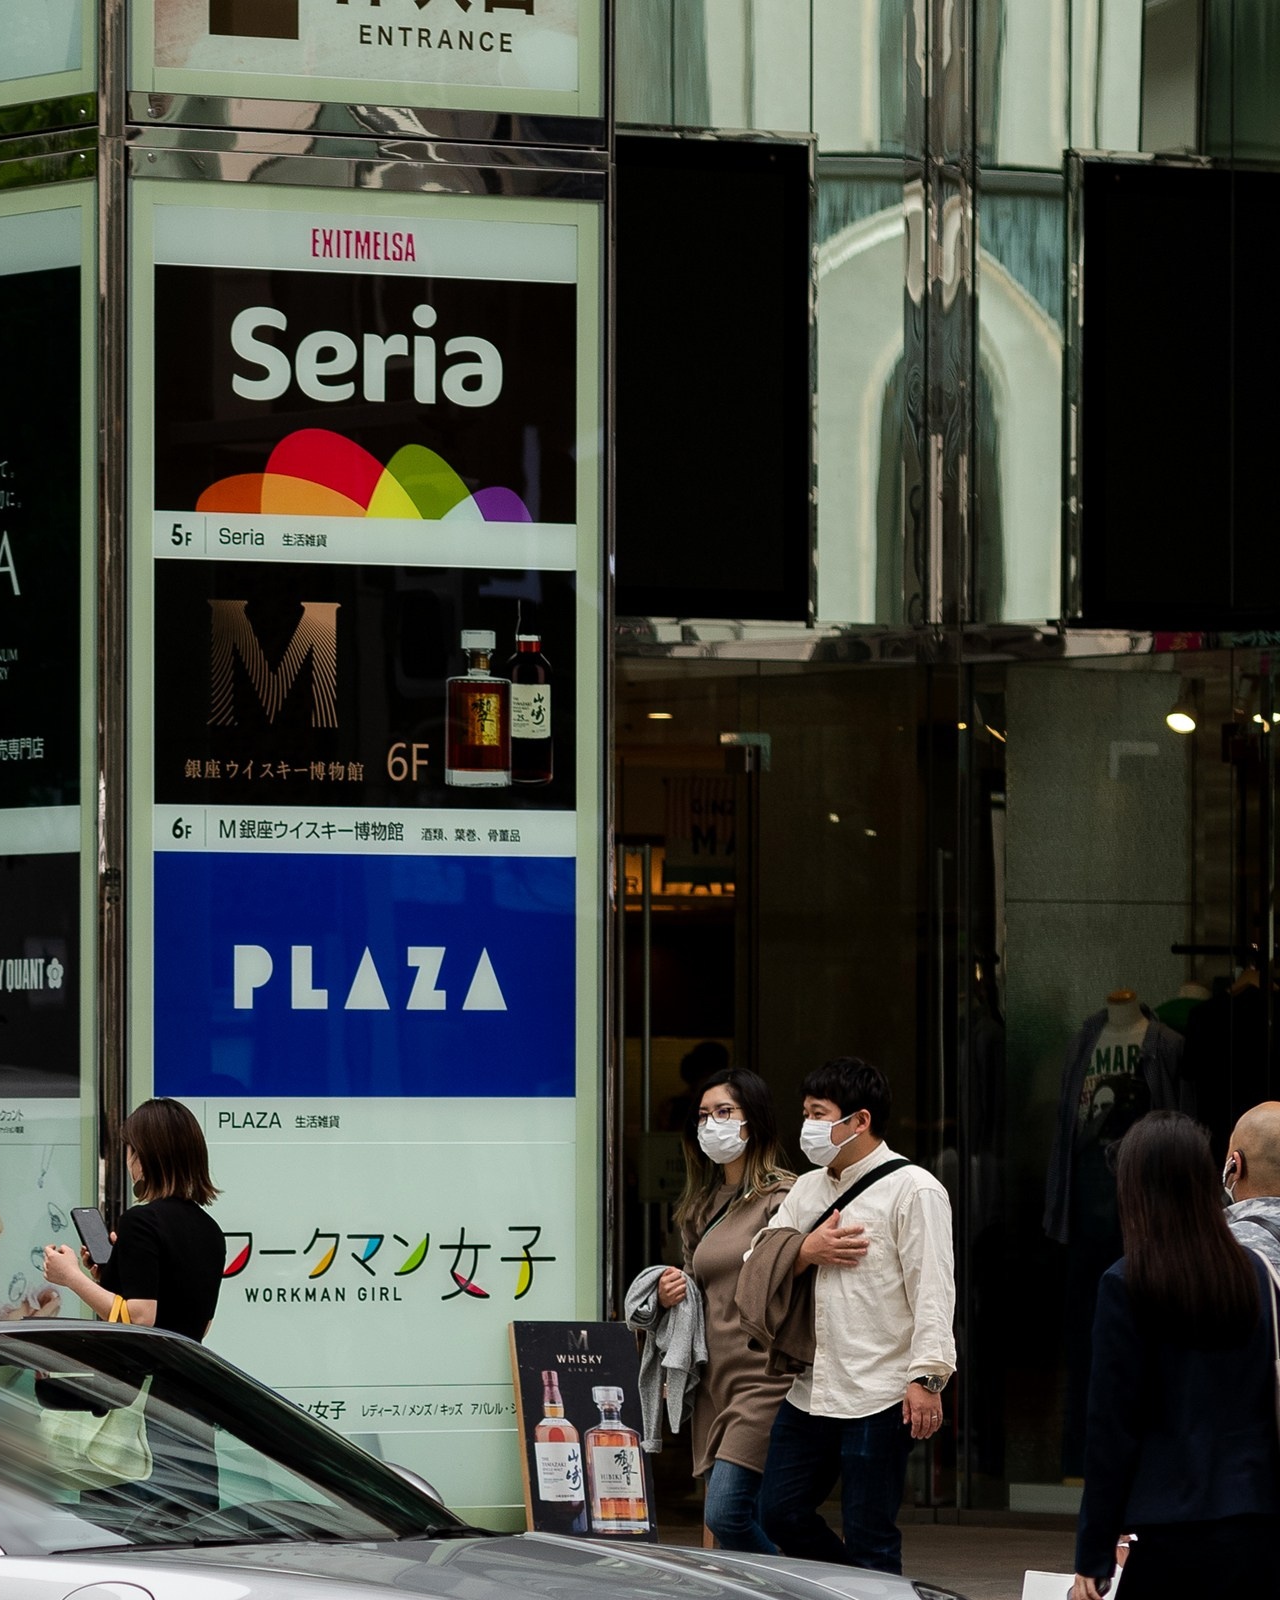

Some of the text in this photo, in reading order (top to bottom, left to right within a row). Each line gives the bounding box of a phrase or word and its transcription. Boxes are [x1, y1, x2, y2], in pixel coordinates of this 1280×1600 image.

[359, 24, 513, 53] ENTRANCE
[312, 228, 417, 262] EXITMELSA
[230, 304, 504, 407] Seria
[171, 523, 265, 546] 5F Seria
[282, 533, 327, 547] 生活雑貨
[207, 599, 342, 728] M
[184, 758, 365, 782] 銀座ウイスキー博物館
[386, 742, 429, 781] 6F
[172, 817, 192, 839] 6F
[6, 957, 45, 993] QUANT
[233, 945, 508, 1011] PLAZA
[219, 1112, 282, 1130] PLAZA
[295, 1115, 340, 1130] 生活雑貨
[222, 1226, 557, 1301] ワークマン女子
[245, 1287, 403, 1303] WORKMAN GIRL
[556, 1354, 603, 1365] WHISKY
